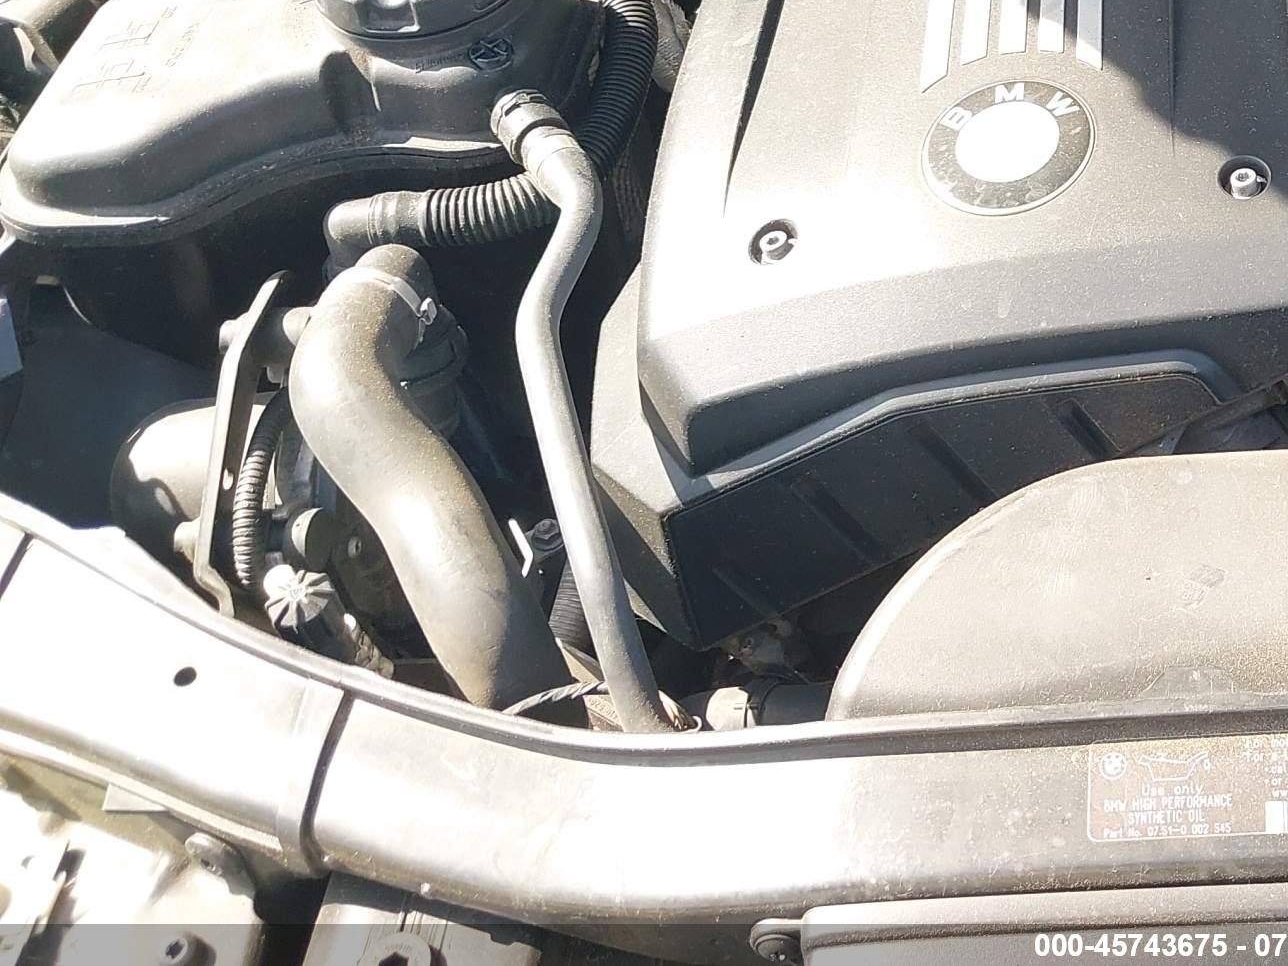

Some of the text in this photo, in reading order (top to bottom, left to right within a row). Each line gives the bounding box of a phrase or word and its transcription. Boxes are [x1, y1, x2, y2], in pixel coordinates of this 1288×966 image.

[939, 82, 1081, 131] BMW
[1141, 780, 1203, 797] Use only
[1271, 776, 1282, 787] or
[1103, 792, 1233, 813] BMW HIGH PERFORMANCE
[1127, 808, 1205, 826] SYNTHETIC OIL
[1103, 827, 1123, 839] Part
[1191, 822, 1209, 835] 002
[1213, 821, 1231, 834] 545
